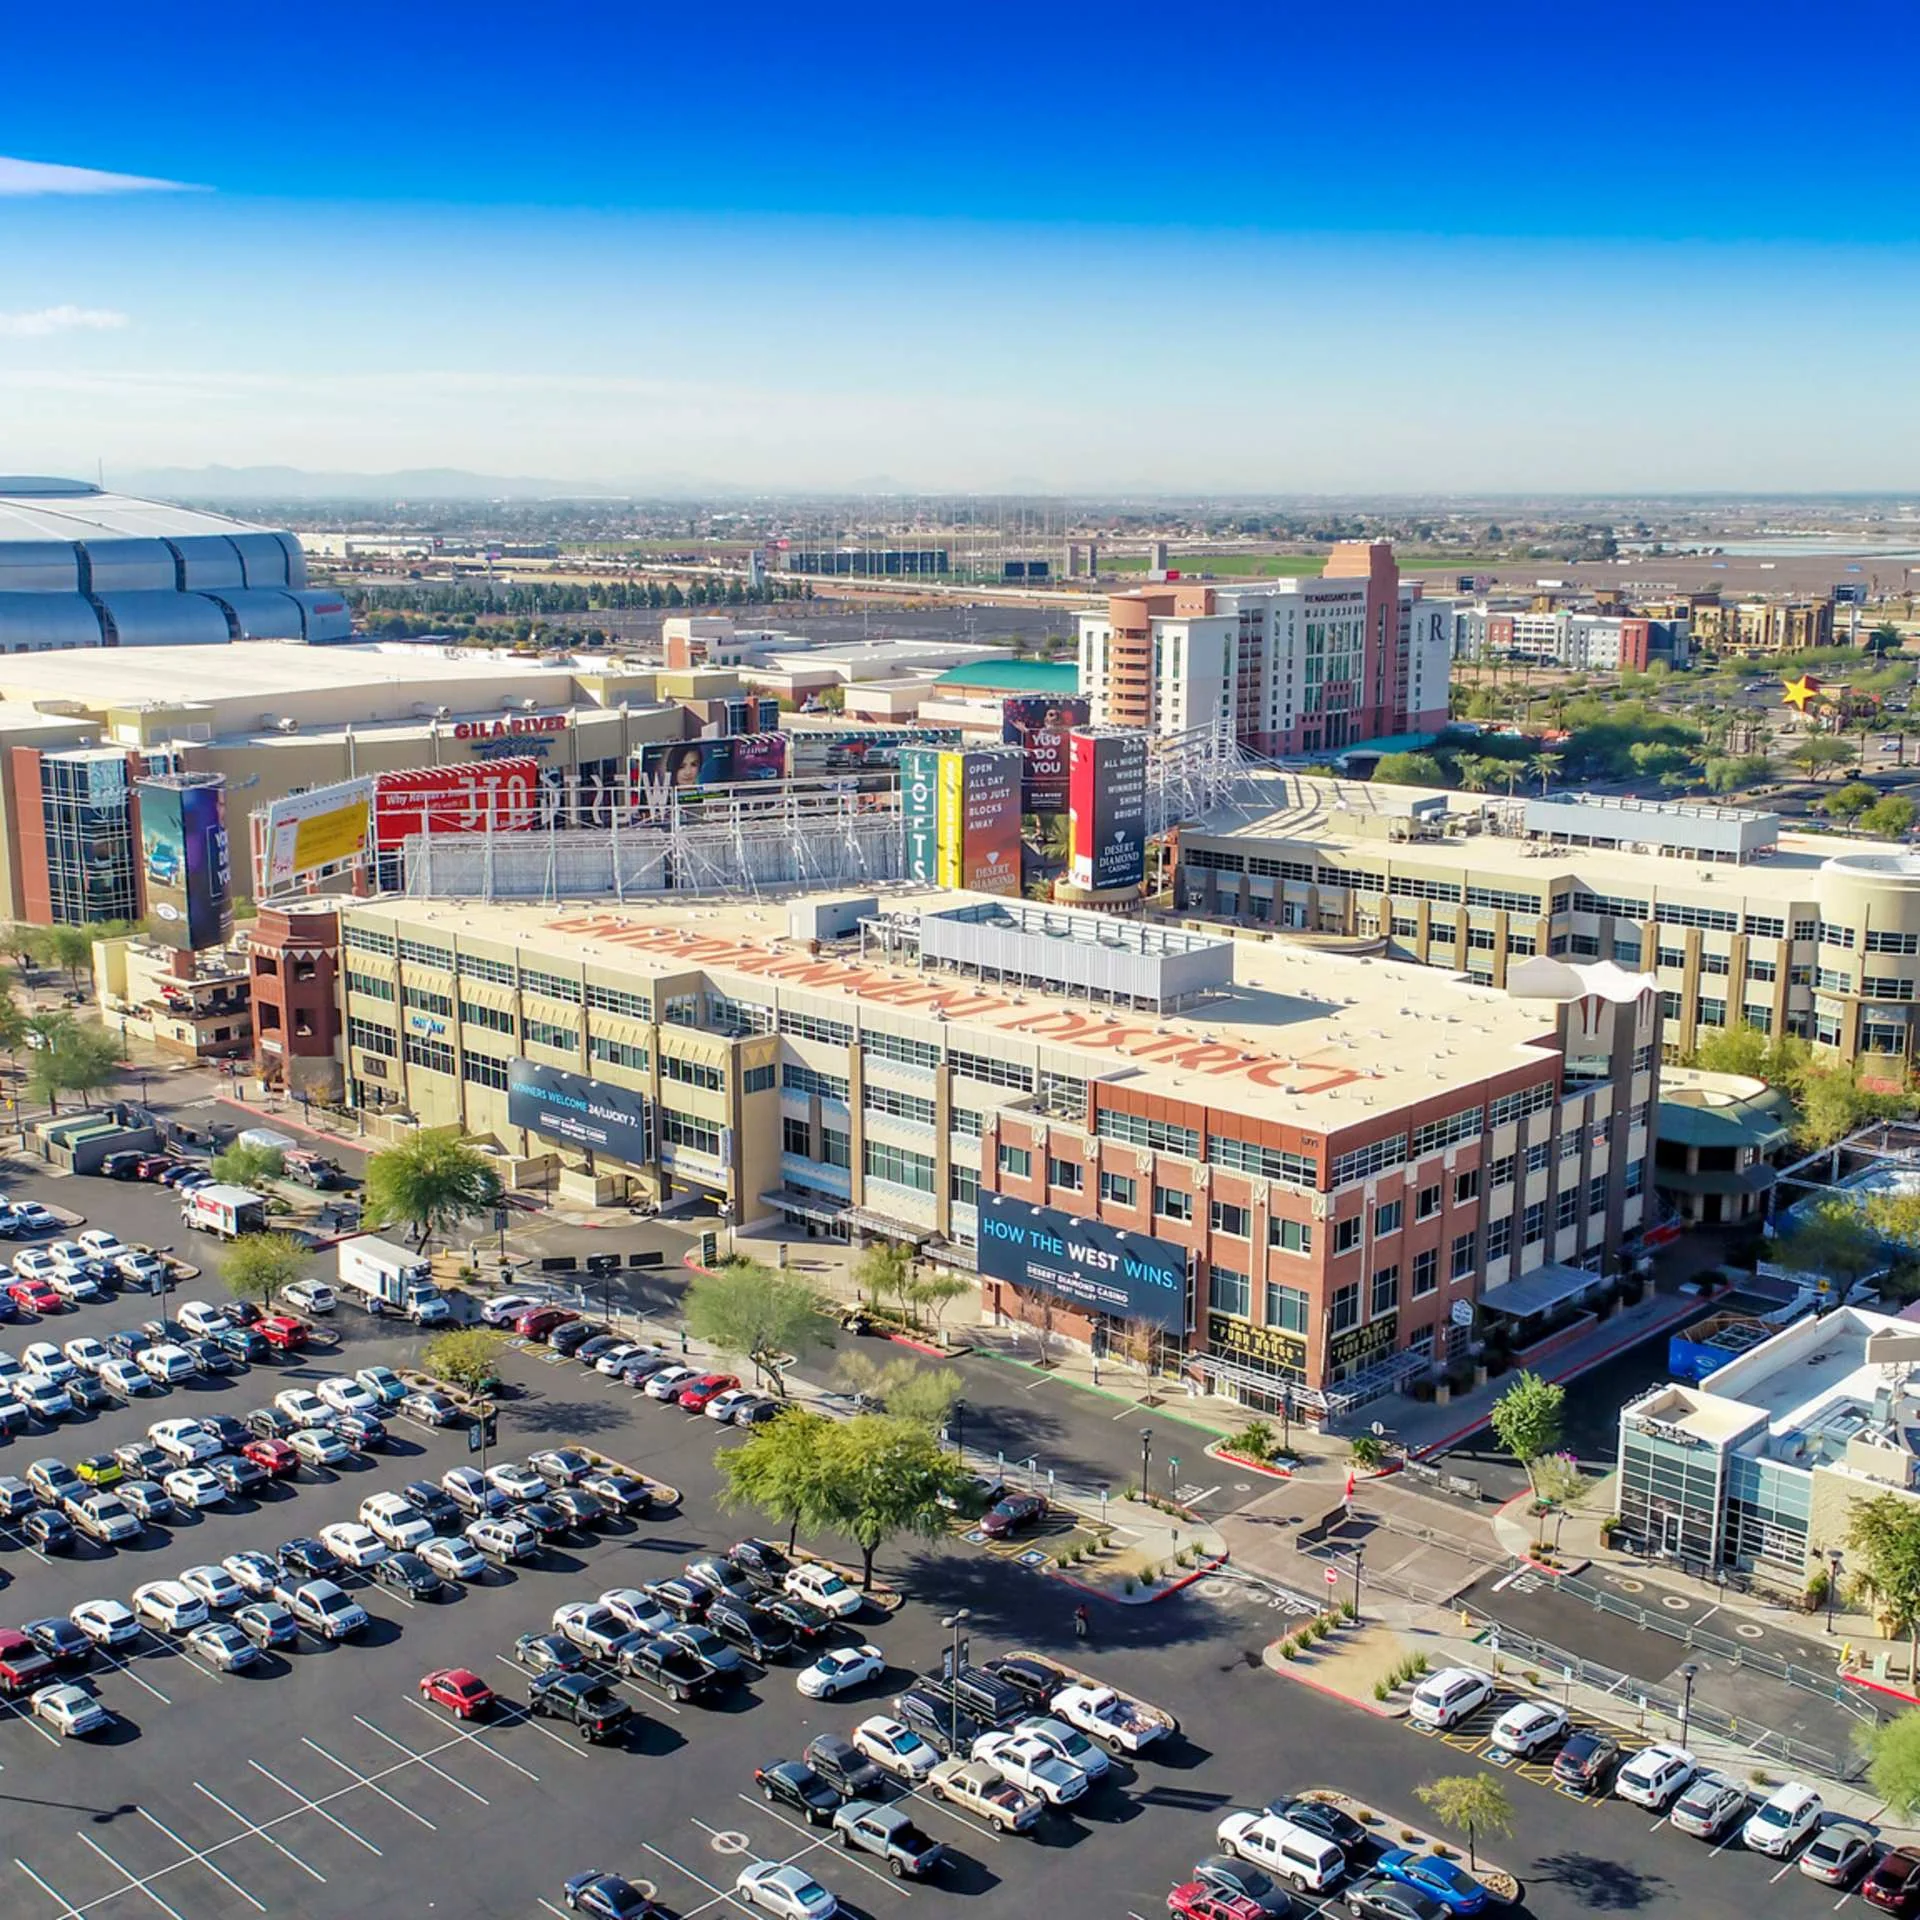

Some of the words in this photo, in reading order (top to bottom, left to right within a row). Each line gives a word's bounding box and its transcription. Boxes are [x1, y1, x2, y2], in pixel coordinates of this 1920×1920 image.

[1431, 613, 1445, 642] R
[454, 720, 505, 739] GILA
[511, 715, 566, 736] RIVER
[1035, 749, 1057, 760] DO
[1123, 743, 1143, 753] OPEN
[1032, 762, 1061, 773] YOU
[1103, 760, 1119, 768] ALL
[1120, 756, 1142, 766] NIGHT
[969, 764, 992, 774] OPEN
[1116, 769, 1142, 779] WHERE
[969, 780, 985, 788] ALL
[988, 776, 1004, 786] DAY
[1108, 782, 1142, 794] WINNERS
[969, 793, 987, 802] AND
[989, 788, 1010, 799] JUST
[1120, 795, 1142, 805] SHINE
[969, 803, 1002, 817] BLOCKS
[1114, 808, 1142, 819] BRIGHT
[969, 818, 994, 830] AWAY
[1104, 841, 1135, 856] DESERT
[1099, 851, 1140, 868] DIAMOND
[975, 863, 1010, 878] DESERT
[1107, 863, 1132, 873] CASINO
[970, 873, 1016, 889] DIAMOND
[541, 914, 1028, 1017] ENTERTAINMENT
[995, 1008, 1386, 1095] DISTRICT
[511, 1081, 547, 1100] WINNERS
[547, 1091, 588, 1113] WELCOME
[984, 1217, 1025, 1244] HOW
[1029, 1230, 1063, 1256] THE
[1067, 1242, 1119, 1272] WEST
[1124, 1258, 1179, 1291] WINS.
[1026, 1265, 1057, 1280] DESERT
[1057, 1275, 1096, 1293] DIAMOND
[1096, 1286, 1129, 1303] CASINO
